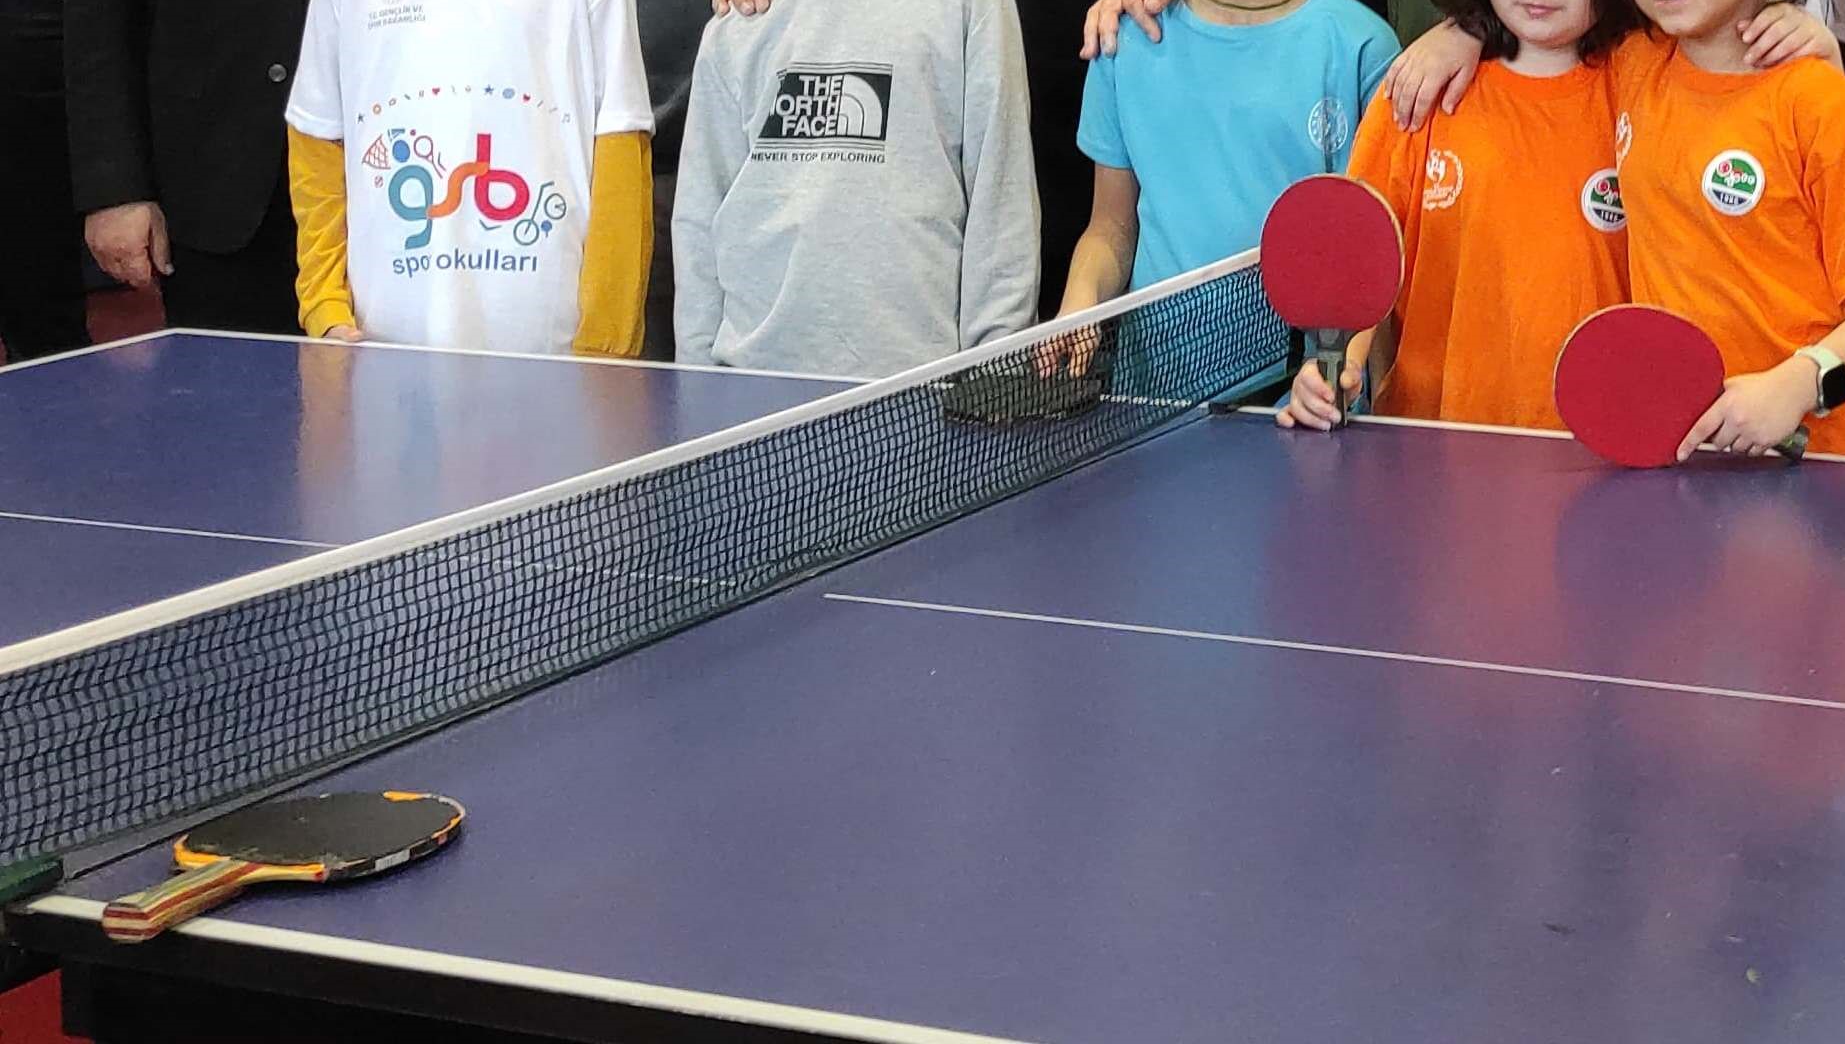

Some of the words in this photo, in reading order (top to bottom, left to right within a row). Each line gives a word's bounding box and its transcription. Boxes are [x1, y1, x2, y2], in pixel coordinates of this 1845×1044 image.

[799, 75, 844, 97] THE
[781, 115, 838, 137] FACE
[791, 152, 819, 163] STOP
[820, 151, 886, 164] EXPLORING
[392, 255, 432, 278] spo
[436, 247, 538, 272] okulları
